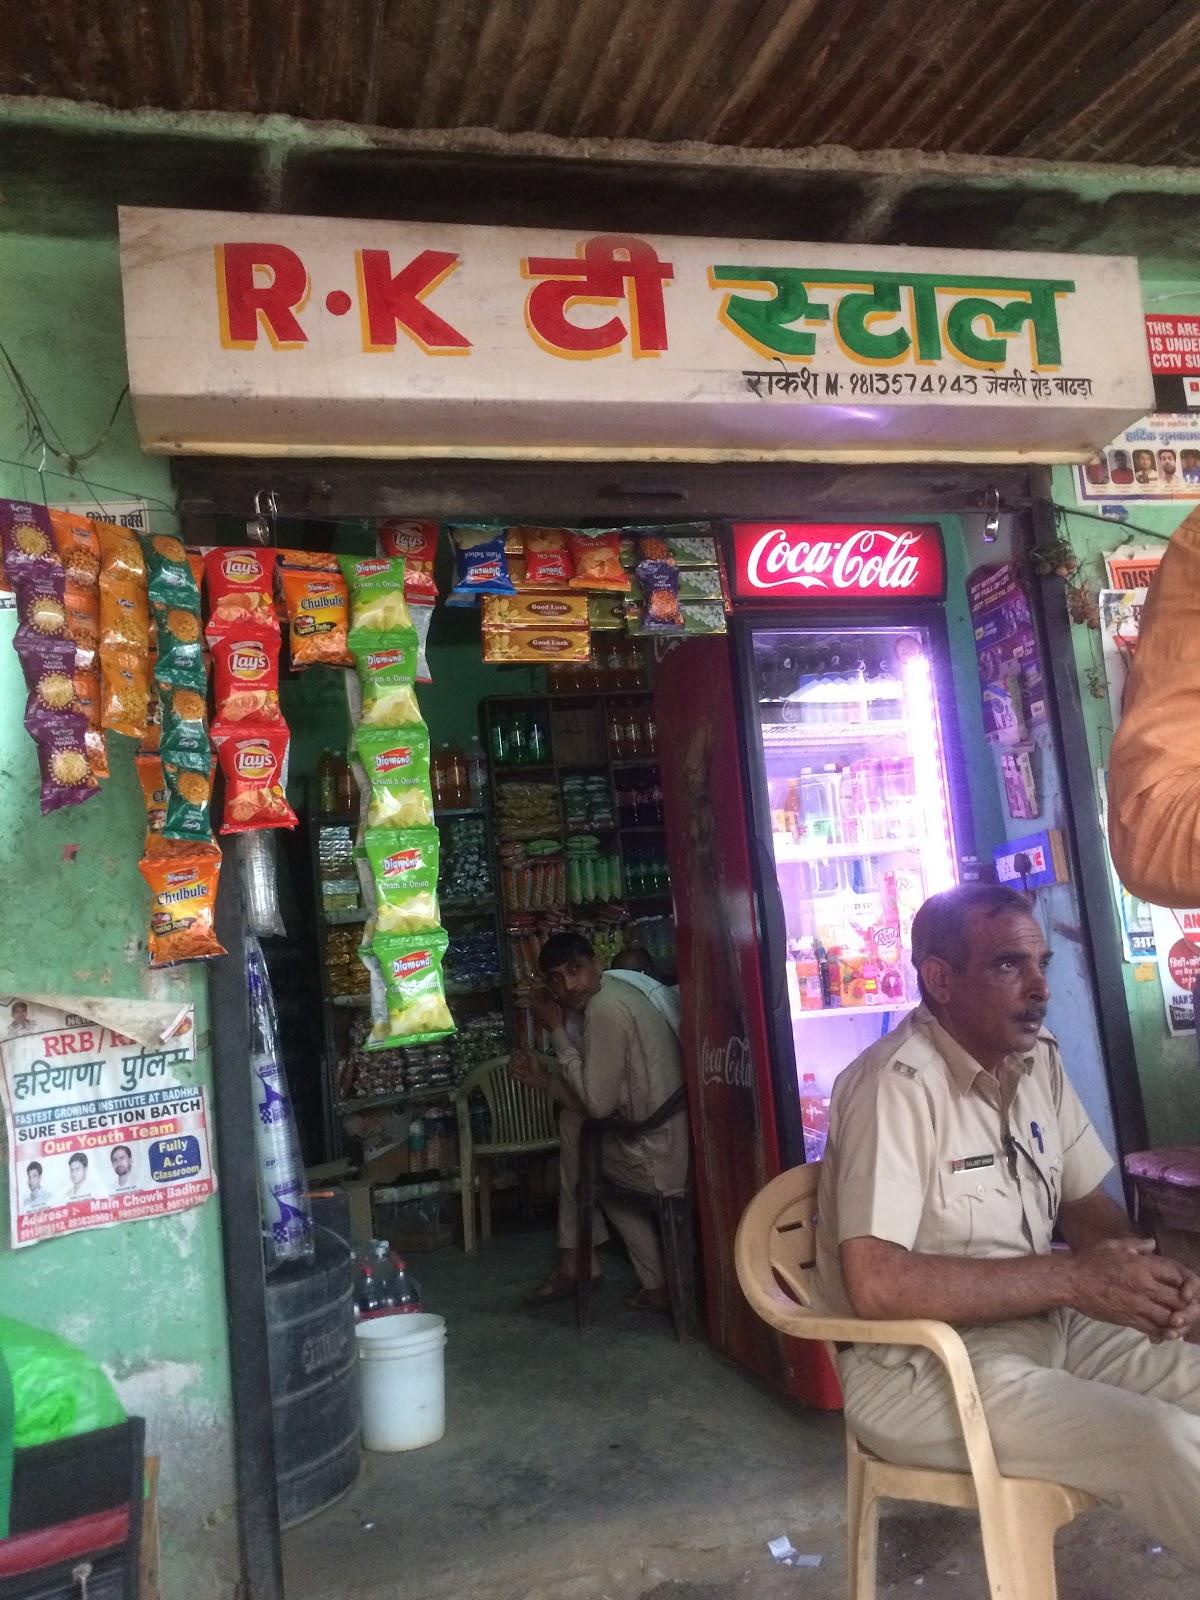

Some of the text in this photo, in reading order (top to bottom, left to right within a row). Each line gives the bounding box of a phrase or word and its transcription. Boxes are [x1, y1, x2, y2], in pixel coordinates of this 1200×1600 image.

[520, 235, 674, 360] टी
[708, 265, 1075, 369] स्टाल
[1147, 322, 1174, 335] THIS
[1150, 338, 1163, 351] IS
[1153, 354, 1182, 368] CCTV
[742, 358, 819, 399] राकेश
[850, 373, 978, 396] 9813574943
[747, 529, 923, 588] Coca-Cola
[356, 563, 391, 573] Diamond
[470, 567, 501, 576] Diamond
[1121, 571, 1157, 589] DIS
[367, 654, 401, 665] Diamond
[375, 756, 411, 766] Diamond
[372, 777, 393, 785] Cream
[400, 777, 420, 785] Onion
[409, 879, 429, 888] Onion
[158, 884, 208, 905] Chulbule
[392, 956, 431, 972] Diamond
[702, 1036, 755, 1087] Coca-Cola
[14, 1059, 106, 1100] हरियाणा
[15, 1110, 52, 1125] FASTEST
[54, 1102, 97, 1117] GROWING
[98, 1094, 147, 1110] INSTITUTE
[148, 1093, 161, 1104] AT
[18, 1099, 201, 1142] SURE SELECTION BATCH
[44, 1121, 175, 1155] Our Youth Team
[158, 1138, 189, 1154] Fully
[163, 1154, 188, 1167] A.C.
[153, 1164, 200, 1181] Classroom
[21, 1208, 68, 1227] Address
[90, 1198, 119, 1212] Main
[123, 1191, 163, 1207] Chowk
[167, 1182, 209, 1198] Badhra
